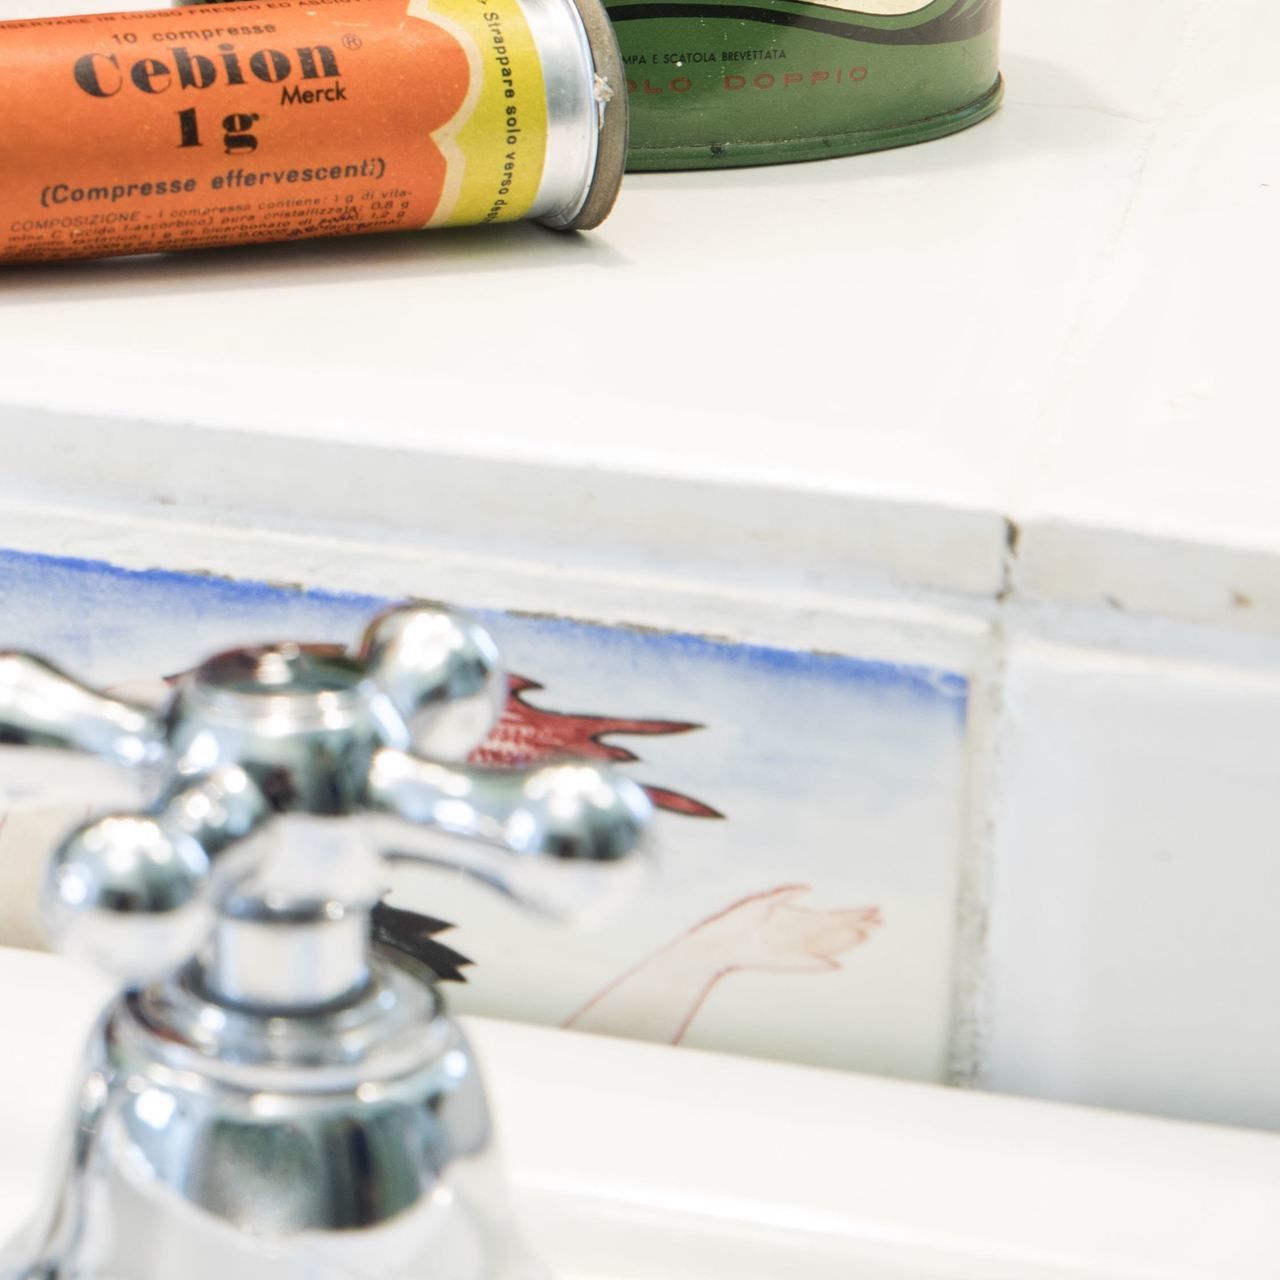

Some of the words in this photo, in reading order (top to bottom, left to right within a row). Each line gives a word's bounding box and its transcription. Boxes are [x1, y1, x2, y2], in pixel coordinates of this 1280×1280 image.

[112, 32, 138, 46] 10
[151, 22, 278, 46] compresse
[482, 11, 517, 98] Strappare
[652, 53, 659, 65] E
[663, 51, 717, 65] SCATOLA
[721, 48, 787, 63] BREVETTATA
[722, 65, 869, 91] DOPPIO
[280, 81, 348, 107] Merck
[505, 105, 522, 146] solo
[40, 176, 197, 209] (Compresse
[210, 157, 387, 192] effervescenti)
[498, 150, 519, 195] verso
[9, 211, 141, 231] COMPOSIZIONE
